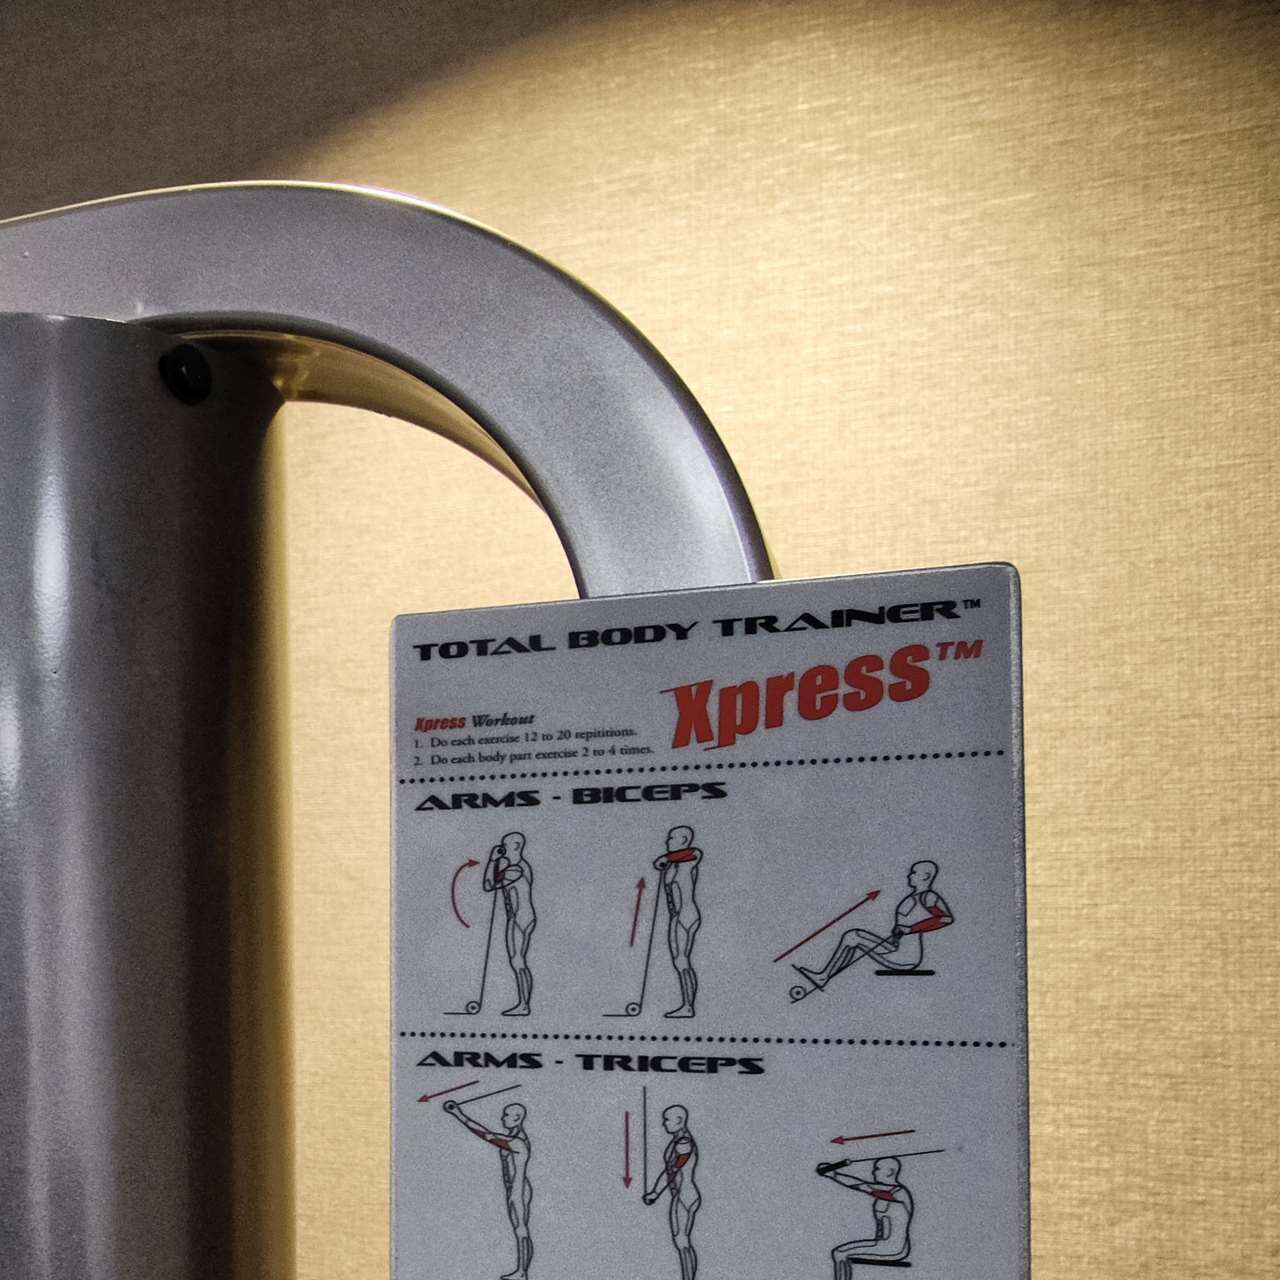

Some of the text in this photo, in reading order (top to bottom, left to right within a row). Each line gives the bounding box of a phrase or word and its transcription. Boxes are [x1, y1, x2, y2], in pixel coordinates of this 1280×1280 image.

[412, 634, 557, 661] TOTAL
[567, 621, 700, 649] BODY
[414, 712, 535, 732] Xpress Workout
[430, 737, 448, 748] Do
[450, 735, 476, 747] each
[478, 734, 521, 745] exercise
[524, 731, 537, 742] 12
[542, 732, 553, 741] to
[557, 729, 572, 741] 20
[431, 755, 448, 766] Do
[450, 753, 476, 764] each
[478, 752, 507, 765] body
[509, 752, 532, 764] part
[535, 748, 579, 760] exercise
[582, 746, 590, 757] 2
[593, 747, 605, 757] to
[608, 744, 616, 756] 4
[619, 745, 655, 756] times.
[414, 790, 541, 811] ARMS
[572, 782, 728, 804] BICEPS
[416, 1051, 544, 1069] ARMS
[575, 1053, 766, 1075] TRICEPS
